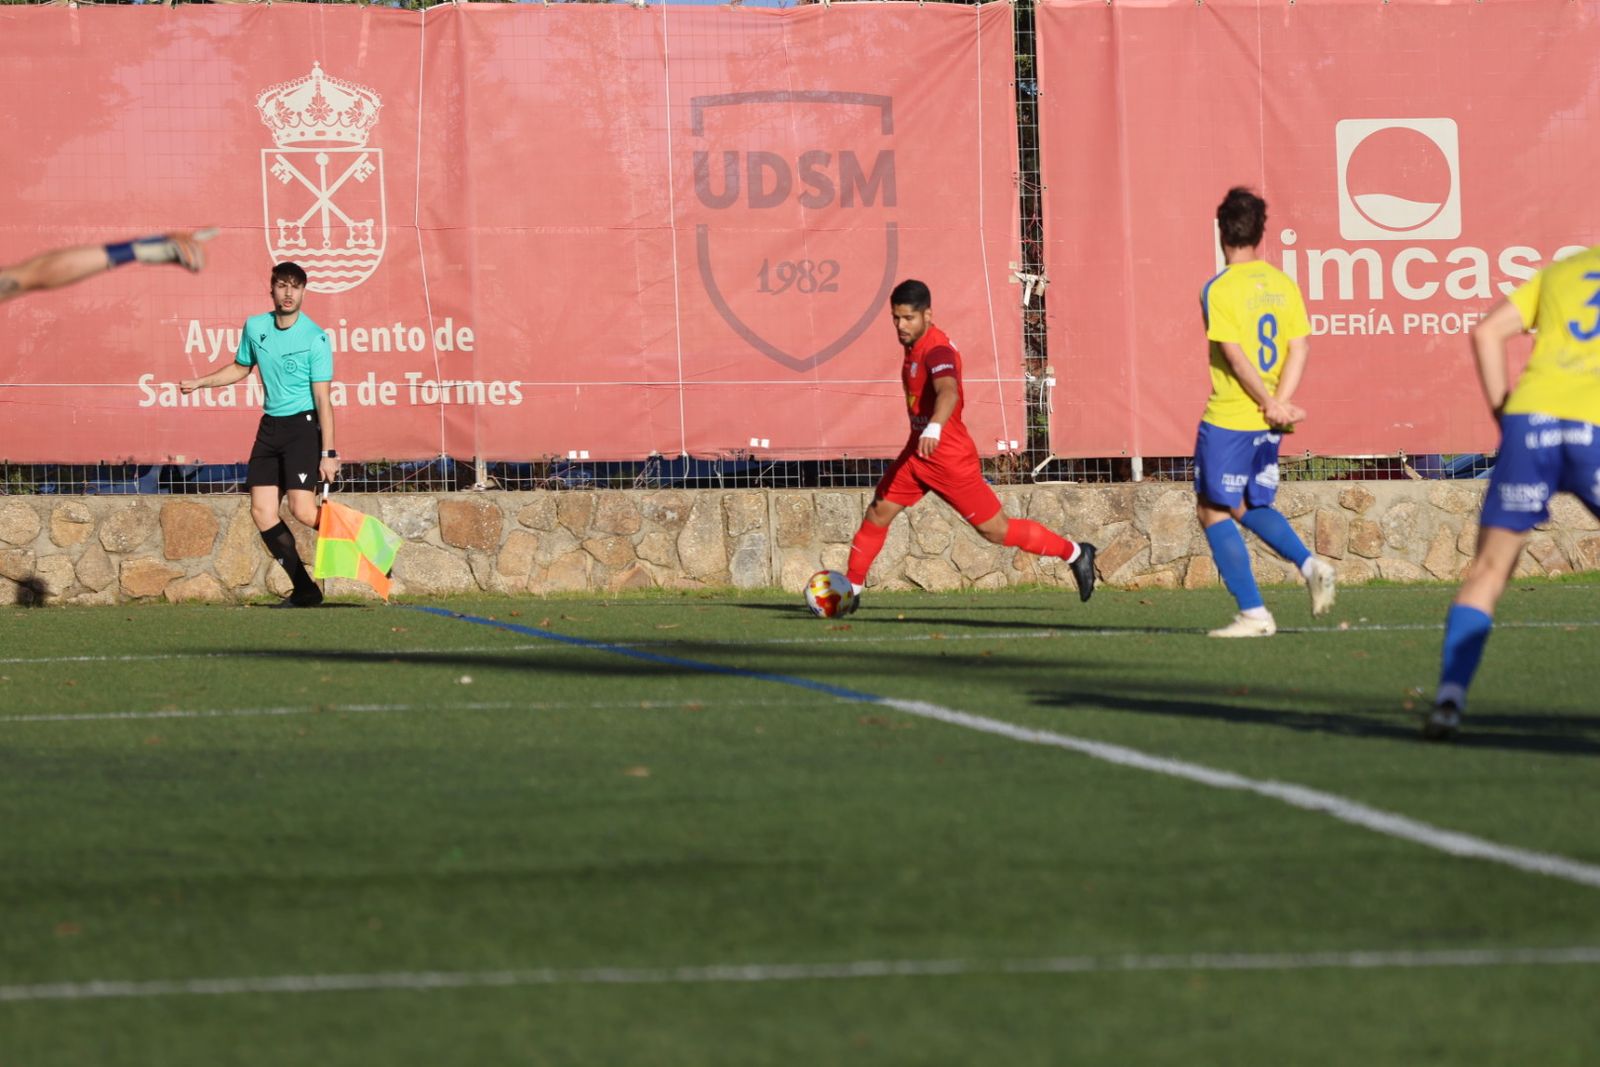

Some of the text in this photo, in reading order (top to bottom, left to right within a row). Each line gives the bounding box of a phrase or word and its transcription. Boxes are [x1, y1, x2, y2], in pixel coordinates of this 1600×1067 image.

[694, 150, 897, 209] UDSM
[757, 258, 840, 295] 1982
[1214, 218, 1590, 300] imcas
[434, 317, 474, 352] de
[1258, 313, 1277, 372] 8
[357, 372, 397, 406] de
[404, 371, 523, 406] Tormes
